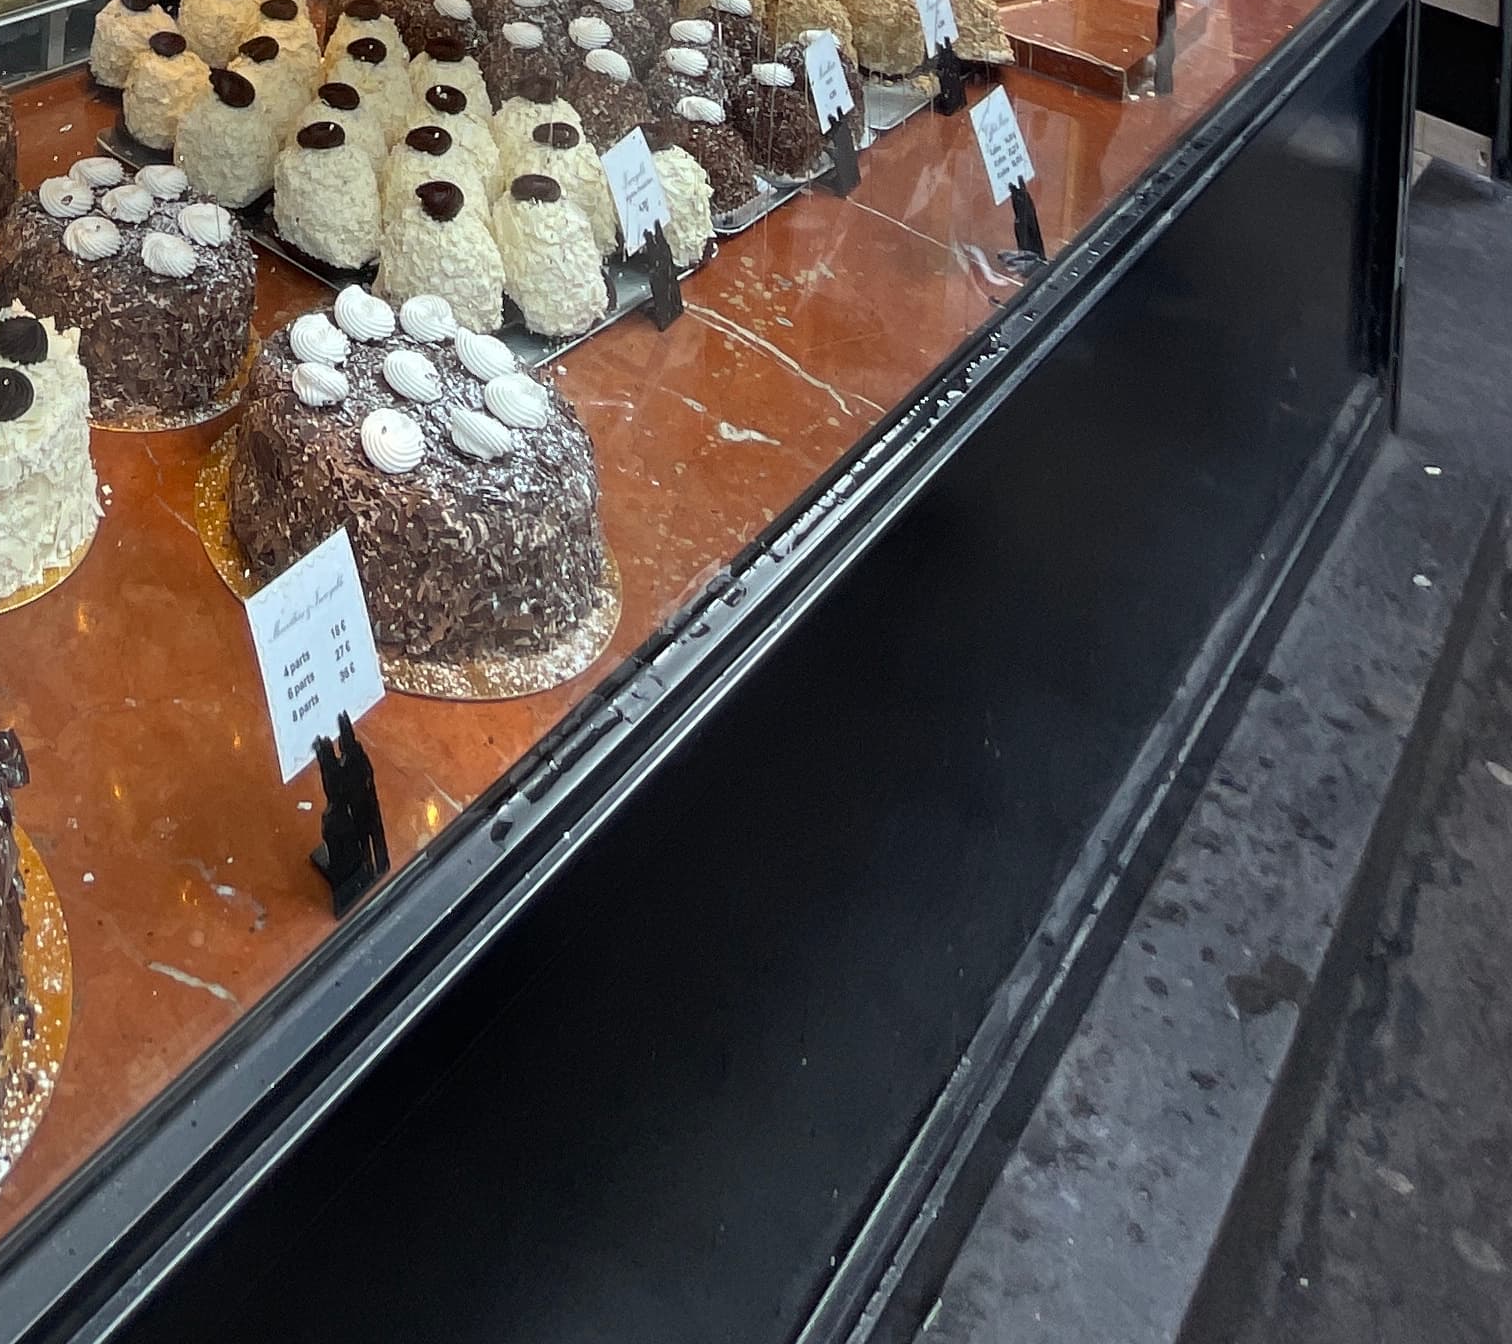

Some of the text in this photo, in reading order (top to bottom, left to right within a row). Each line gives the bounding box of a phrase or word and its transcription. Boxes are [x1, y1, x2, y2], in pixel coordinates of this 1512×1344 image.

[290, 650, 311, 676] parts
[294, 672, 316, 697] parts
[298, 694, 320, 719] parts
